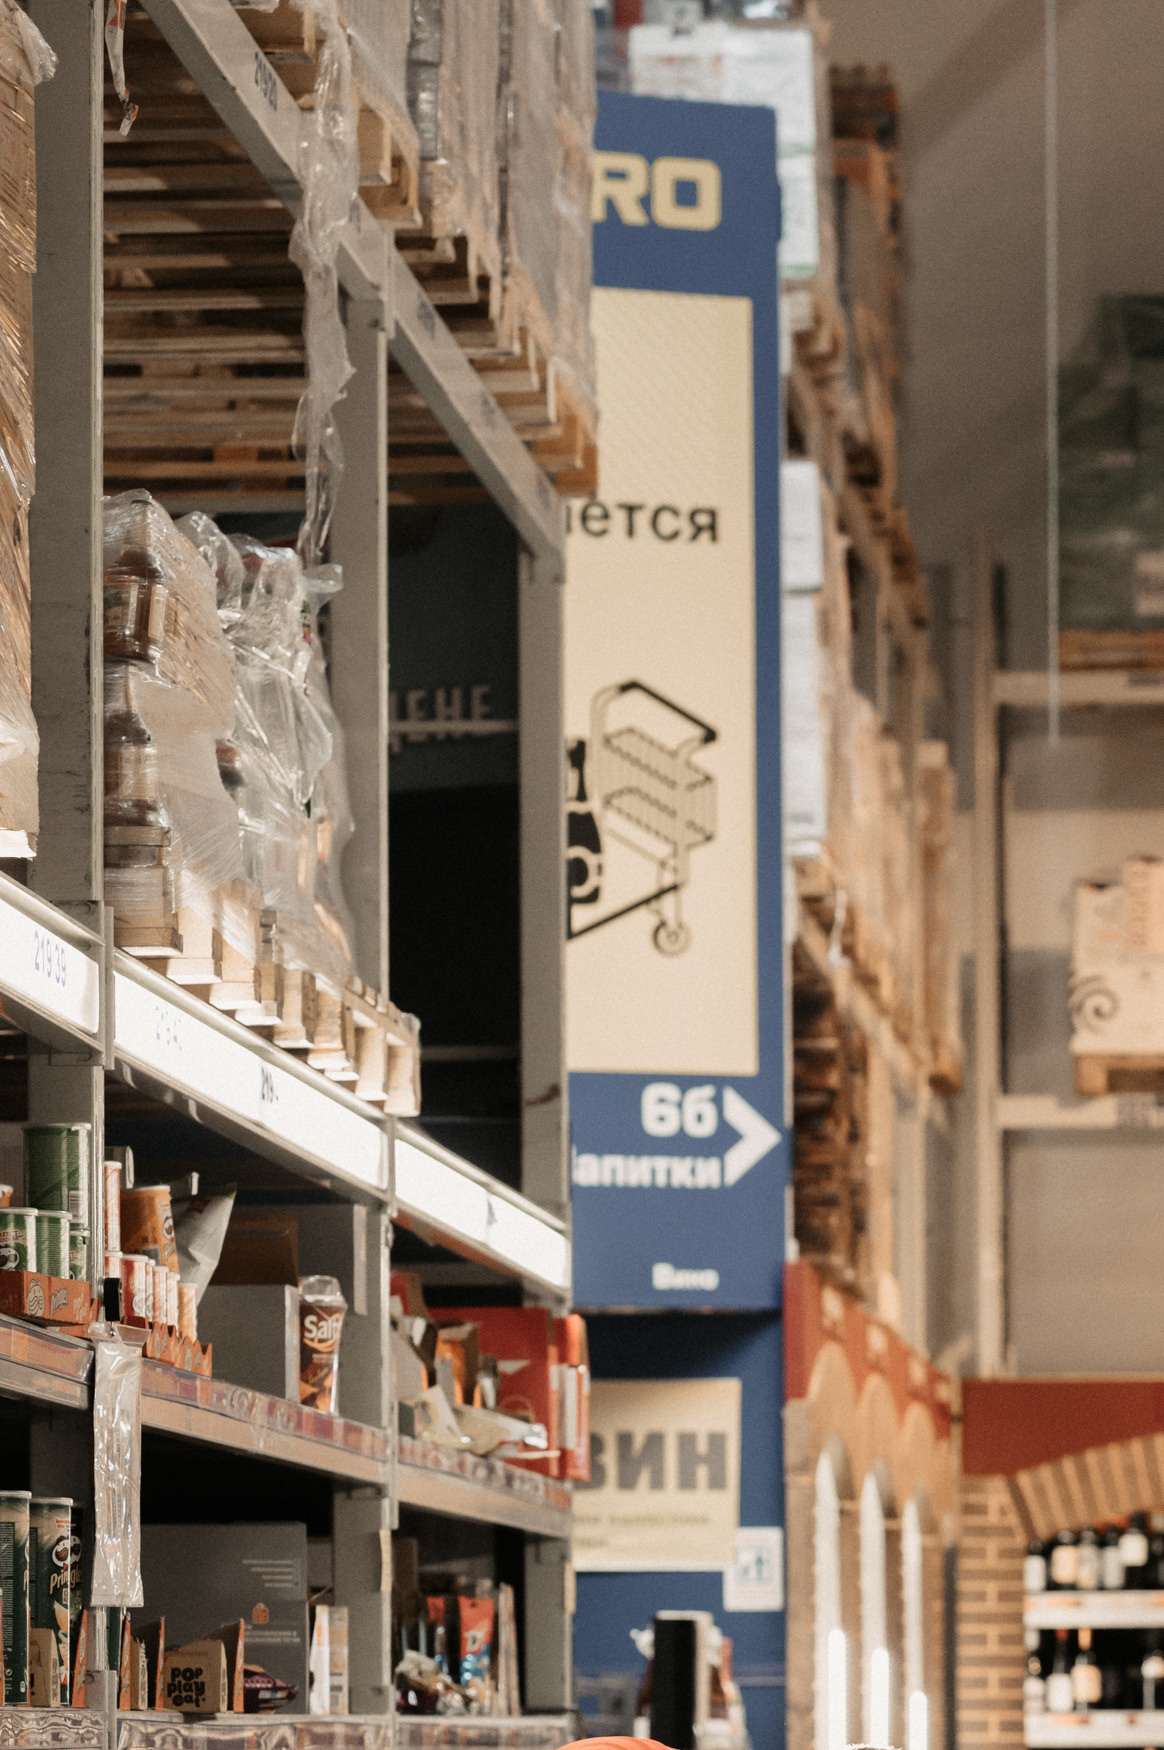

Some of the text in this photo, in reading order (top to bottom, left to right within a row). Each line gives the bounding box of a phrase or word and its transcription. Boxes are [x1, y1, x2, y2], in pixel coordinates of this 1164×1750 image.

[591, 150, 723, 232] RO
[566, 500, 719, 543] ется
[571, 1144, 723, 1190] апитки
